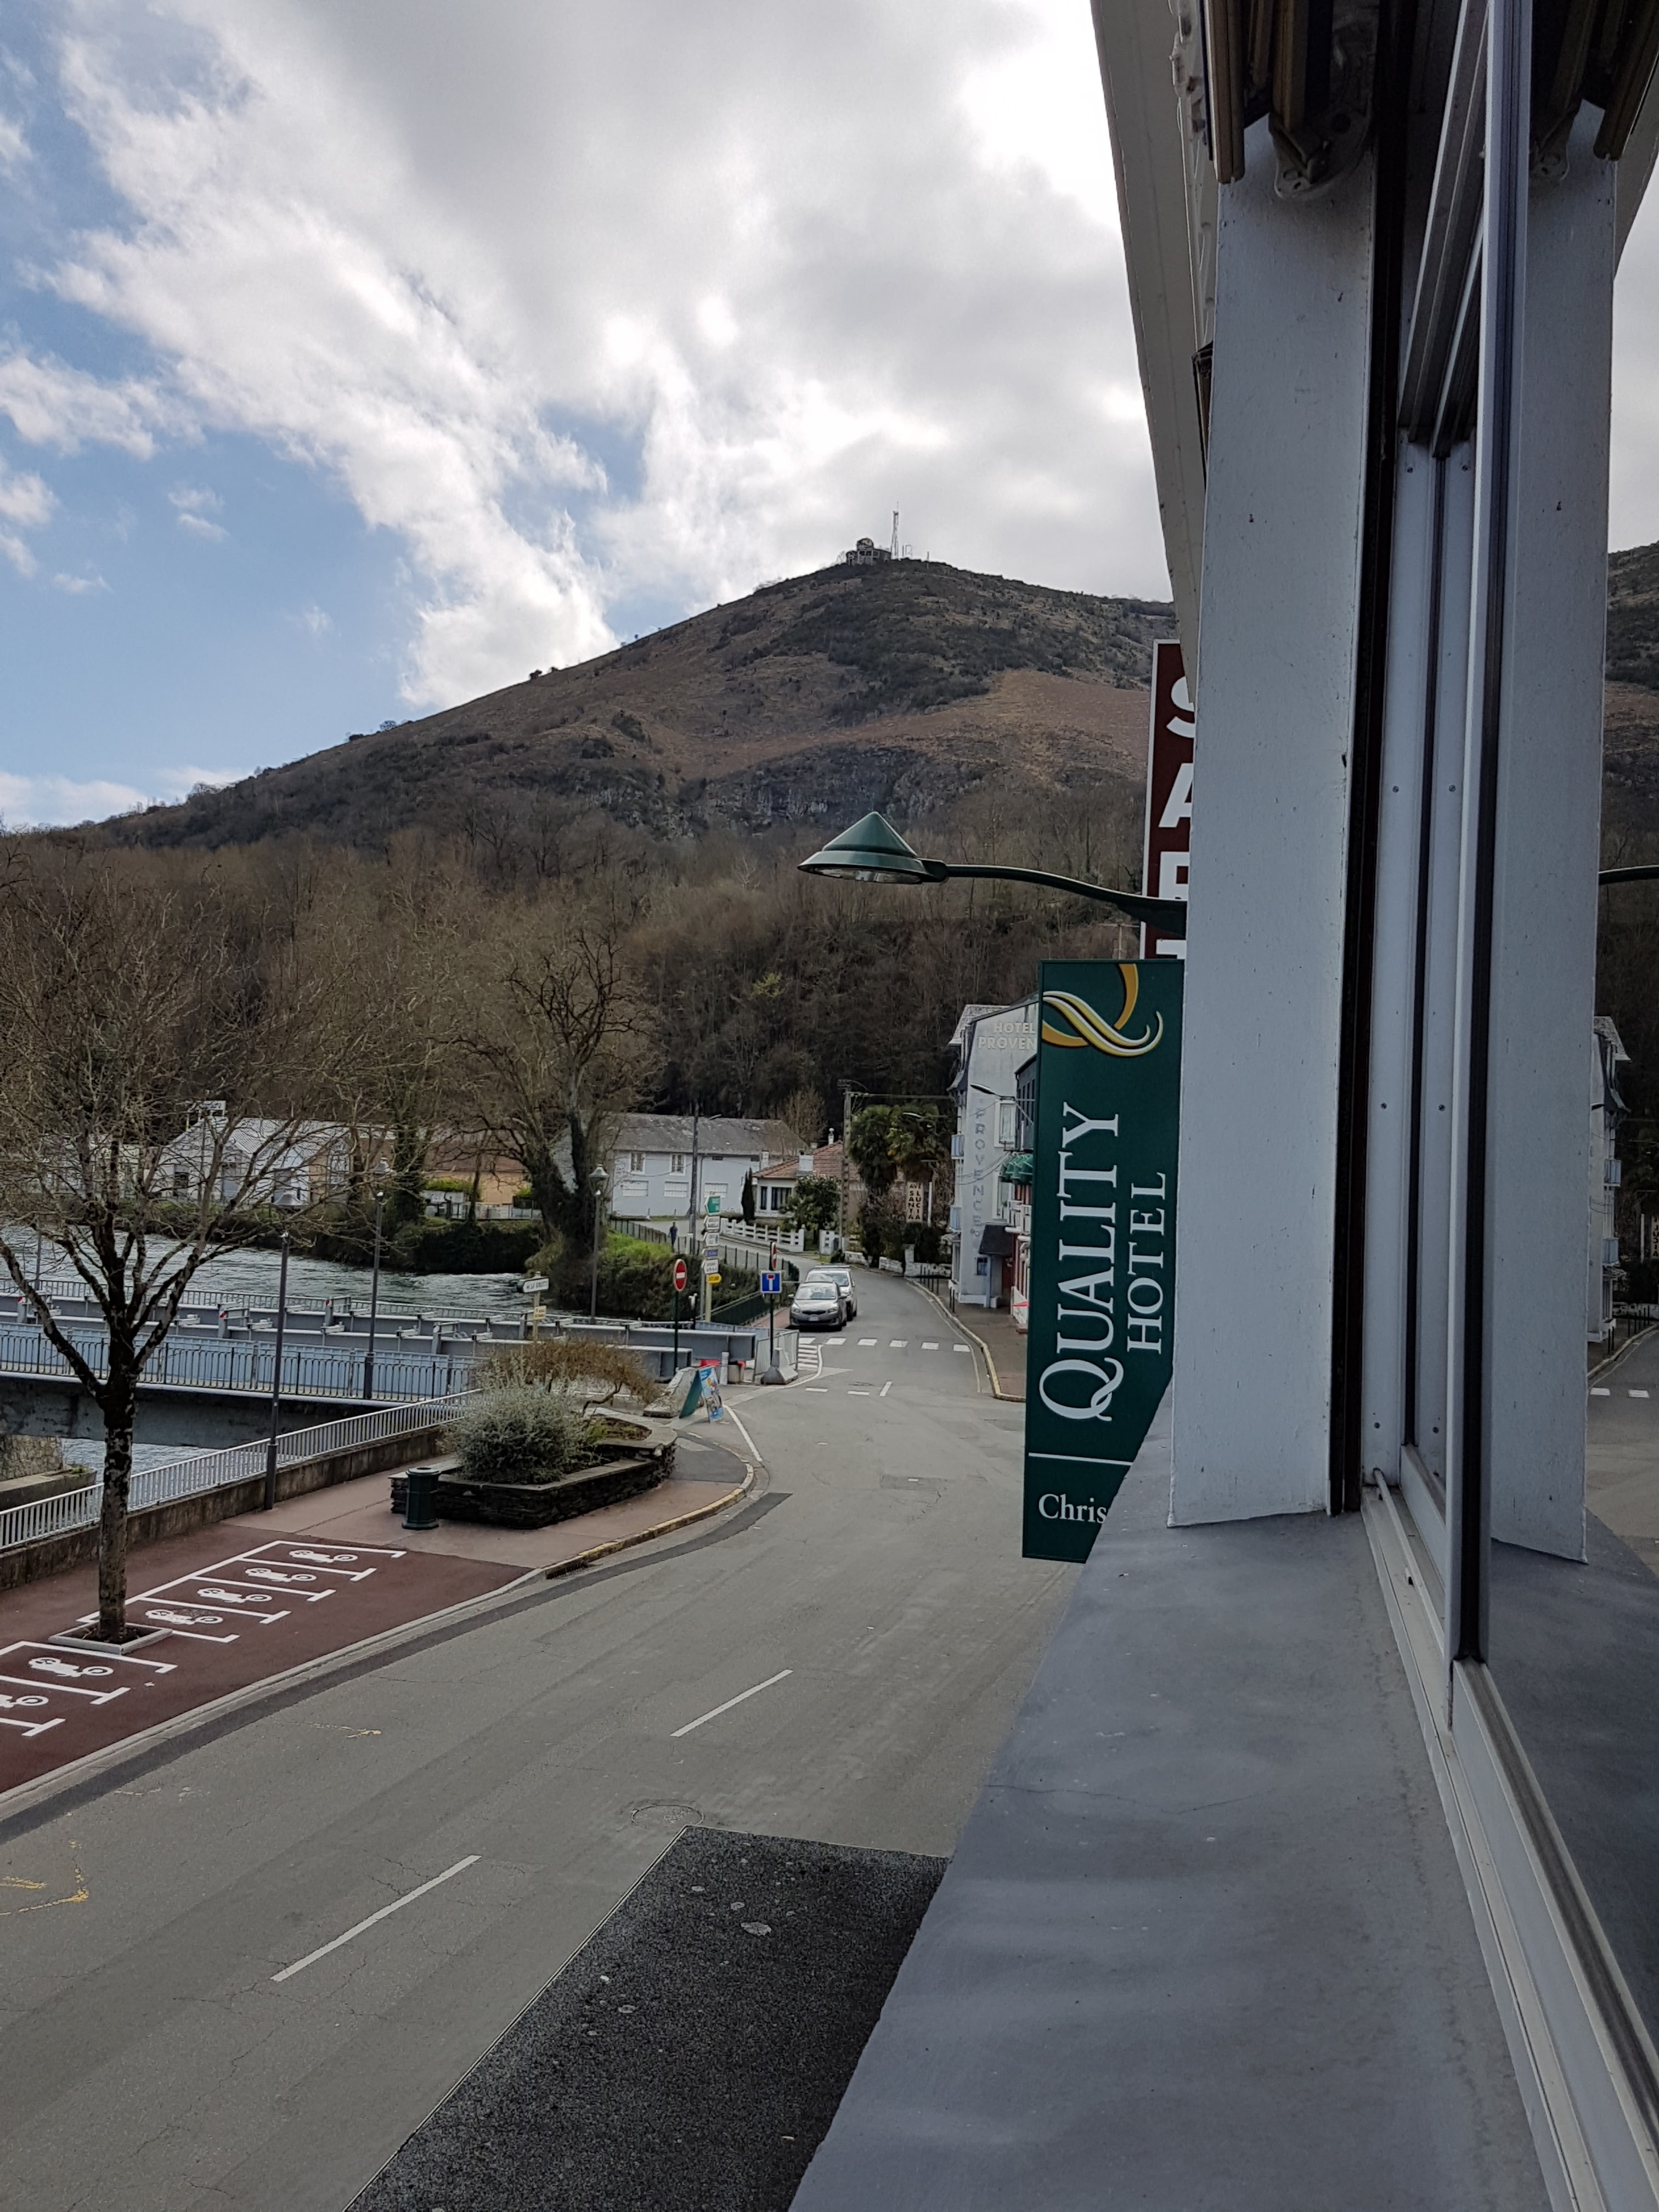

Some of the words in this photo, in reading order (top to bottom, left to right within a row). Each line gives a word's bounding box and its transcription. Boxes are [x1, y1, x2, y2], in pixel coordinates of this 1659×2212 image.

[994, 1022, 1036, 1034] HOTEL
[973, 1107, 986, 1226] PROVENCE
[1039, 1101, 1124, 1422] QUALITY
[1126, 1171, 1166, 1355] HOTEL
[1038, 1493, 1108, 1523] Chris
